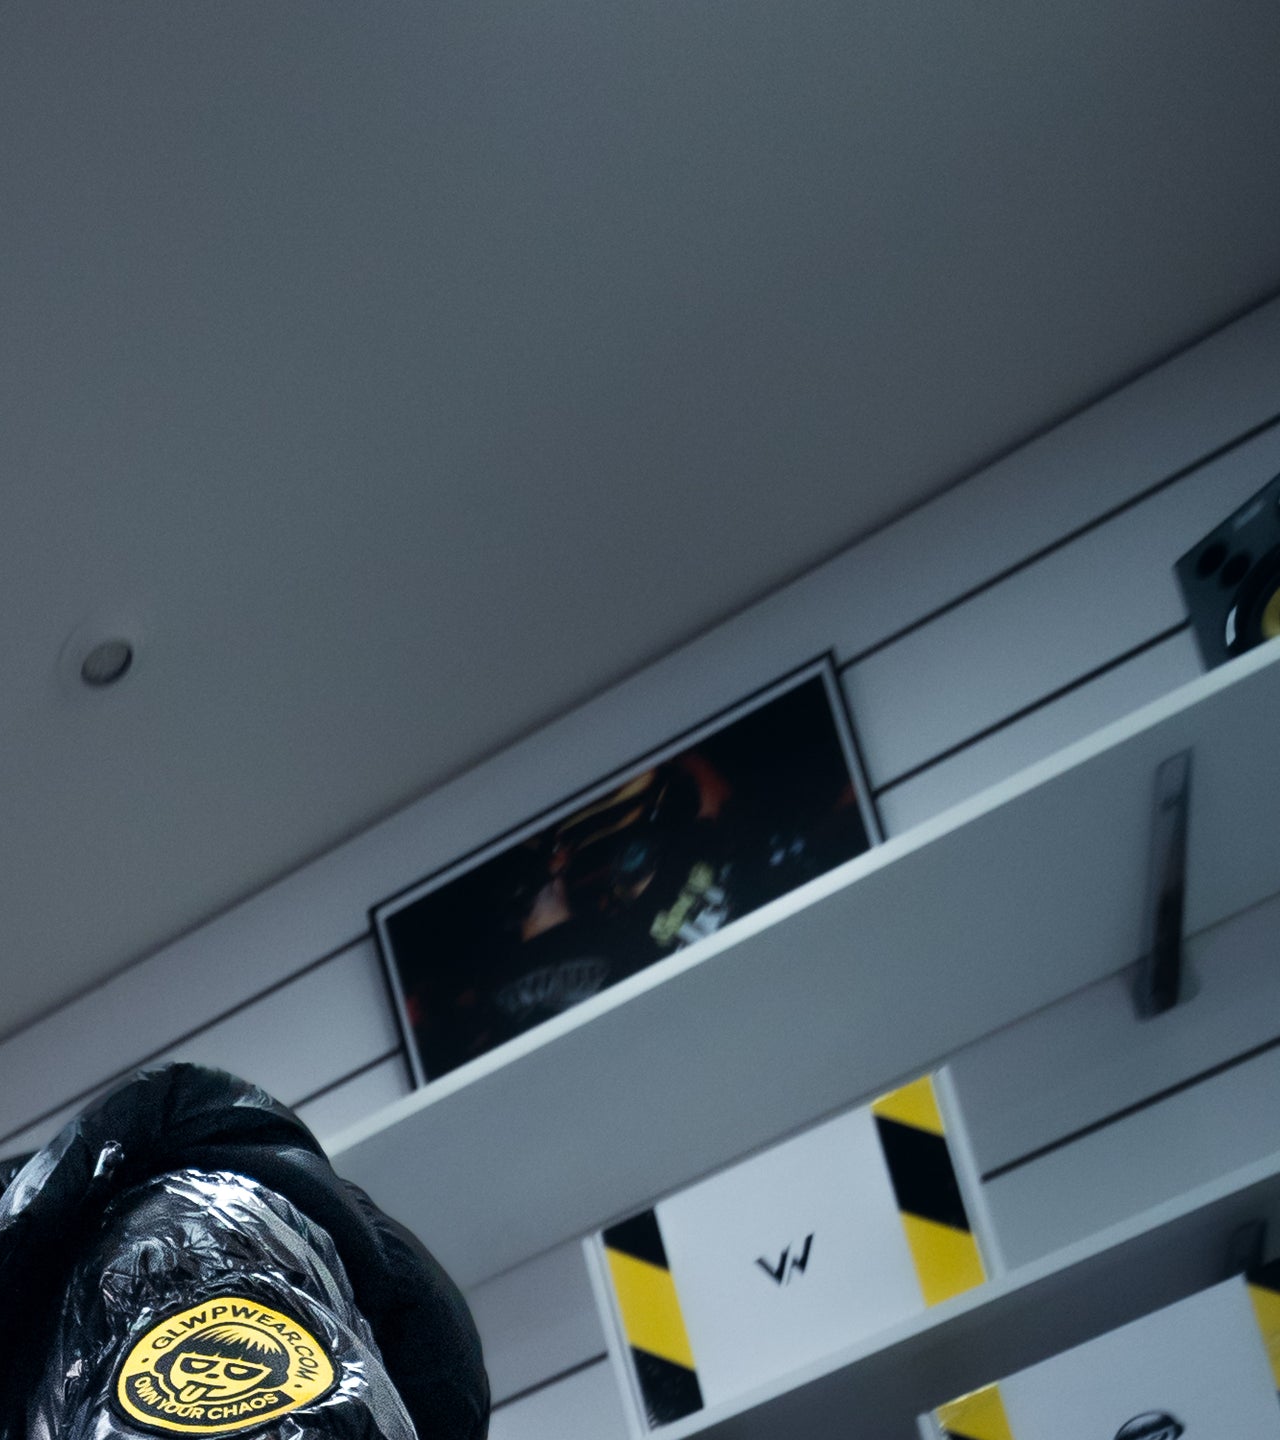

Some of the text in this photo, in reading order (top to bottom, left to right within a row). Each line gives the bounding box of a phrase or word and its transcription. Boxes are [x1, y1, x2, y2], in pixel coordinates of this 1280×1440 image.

[152, 1305, 319, 1382] GLWPWEAR.COM
[157, 1397, 203, 1420] YOUR
[207, 1393, 279, 1420] CHAOS
